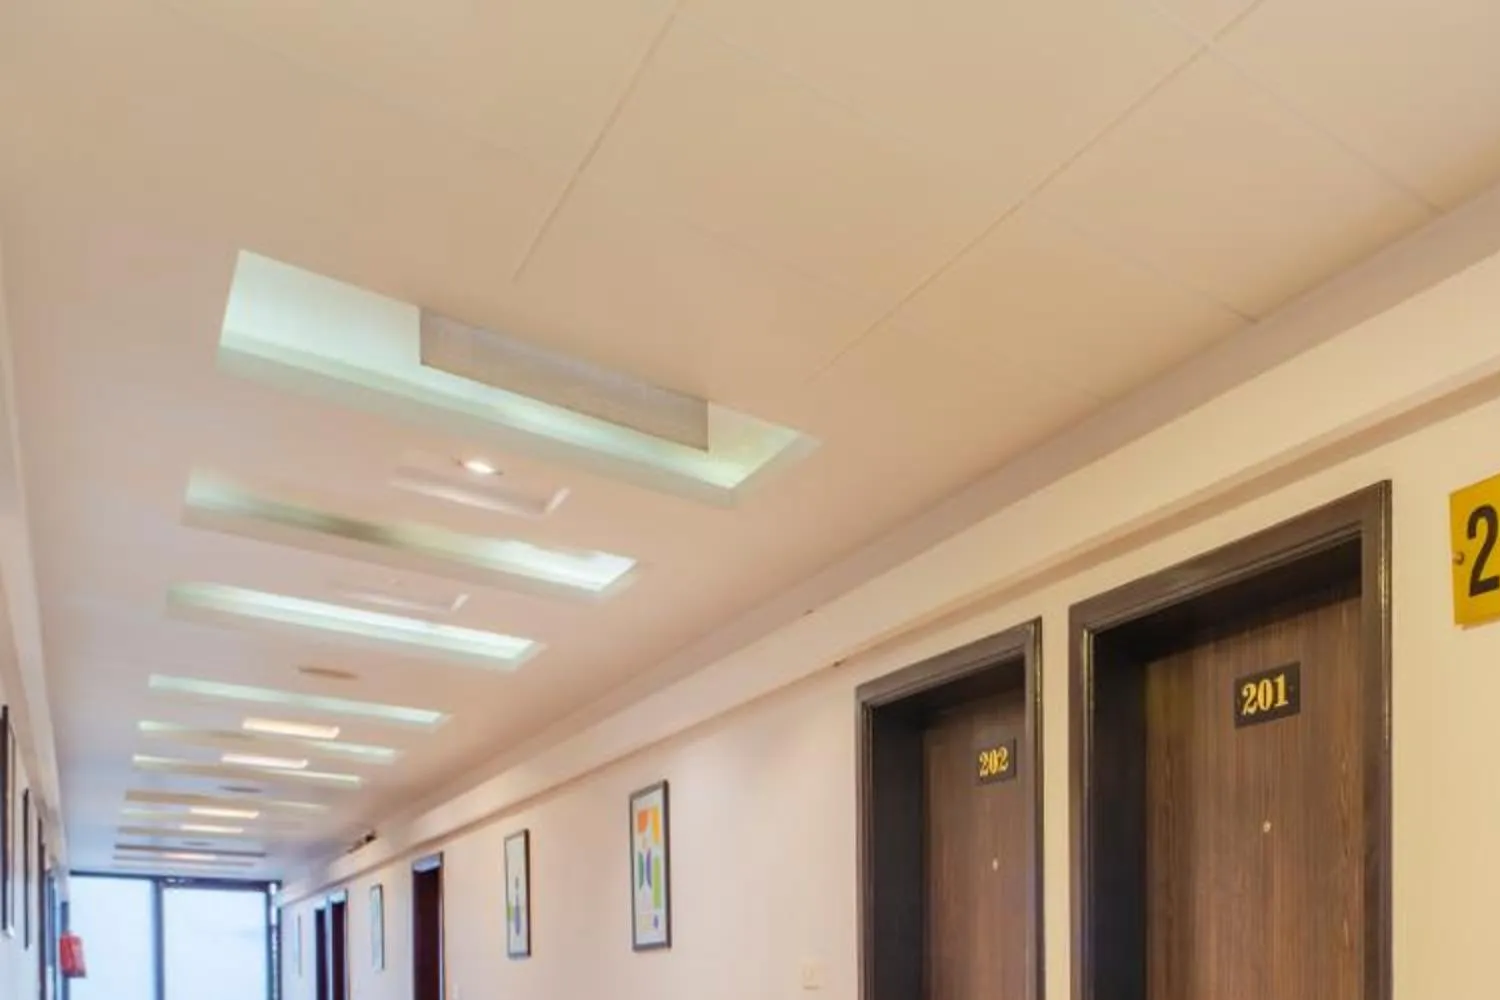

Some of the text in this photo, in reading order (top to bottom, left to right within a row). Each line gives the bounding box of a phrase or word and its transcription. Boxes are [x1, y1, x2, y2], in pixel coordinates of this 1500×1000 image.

[1466, 503, 1500, 598] 2
[1240, 673, 1290, 716] 201
[978, 745, 1010, 779] 202
